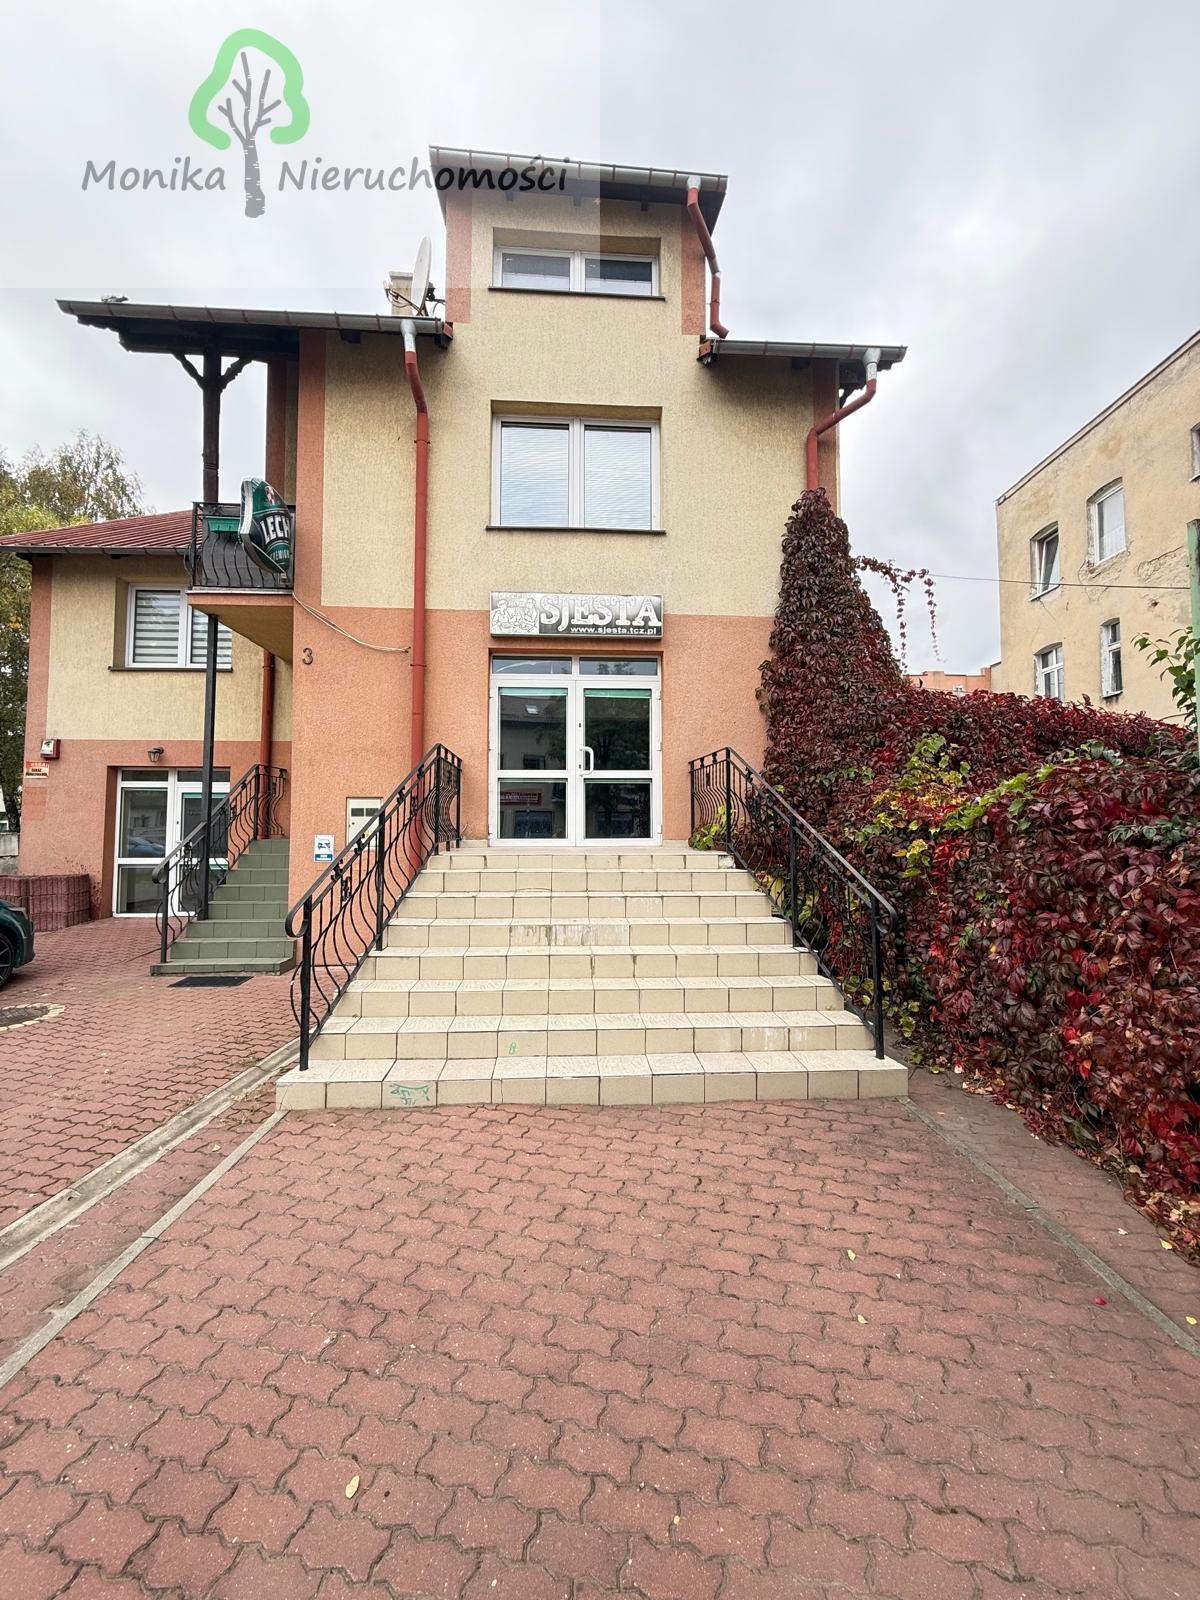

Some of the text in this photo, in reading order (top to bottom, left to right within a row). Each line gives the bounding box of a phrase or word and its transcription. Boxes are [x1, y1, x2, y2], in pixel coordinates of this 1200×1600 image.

[260, 515, 290, 544] LECH
[540, 596, 662, 631] SJESTA
[570, 626, 657, 635] www.sjesta.tcz.pl
[302, 647, 314, 666] 3
